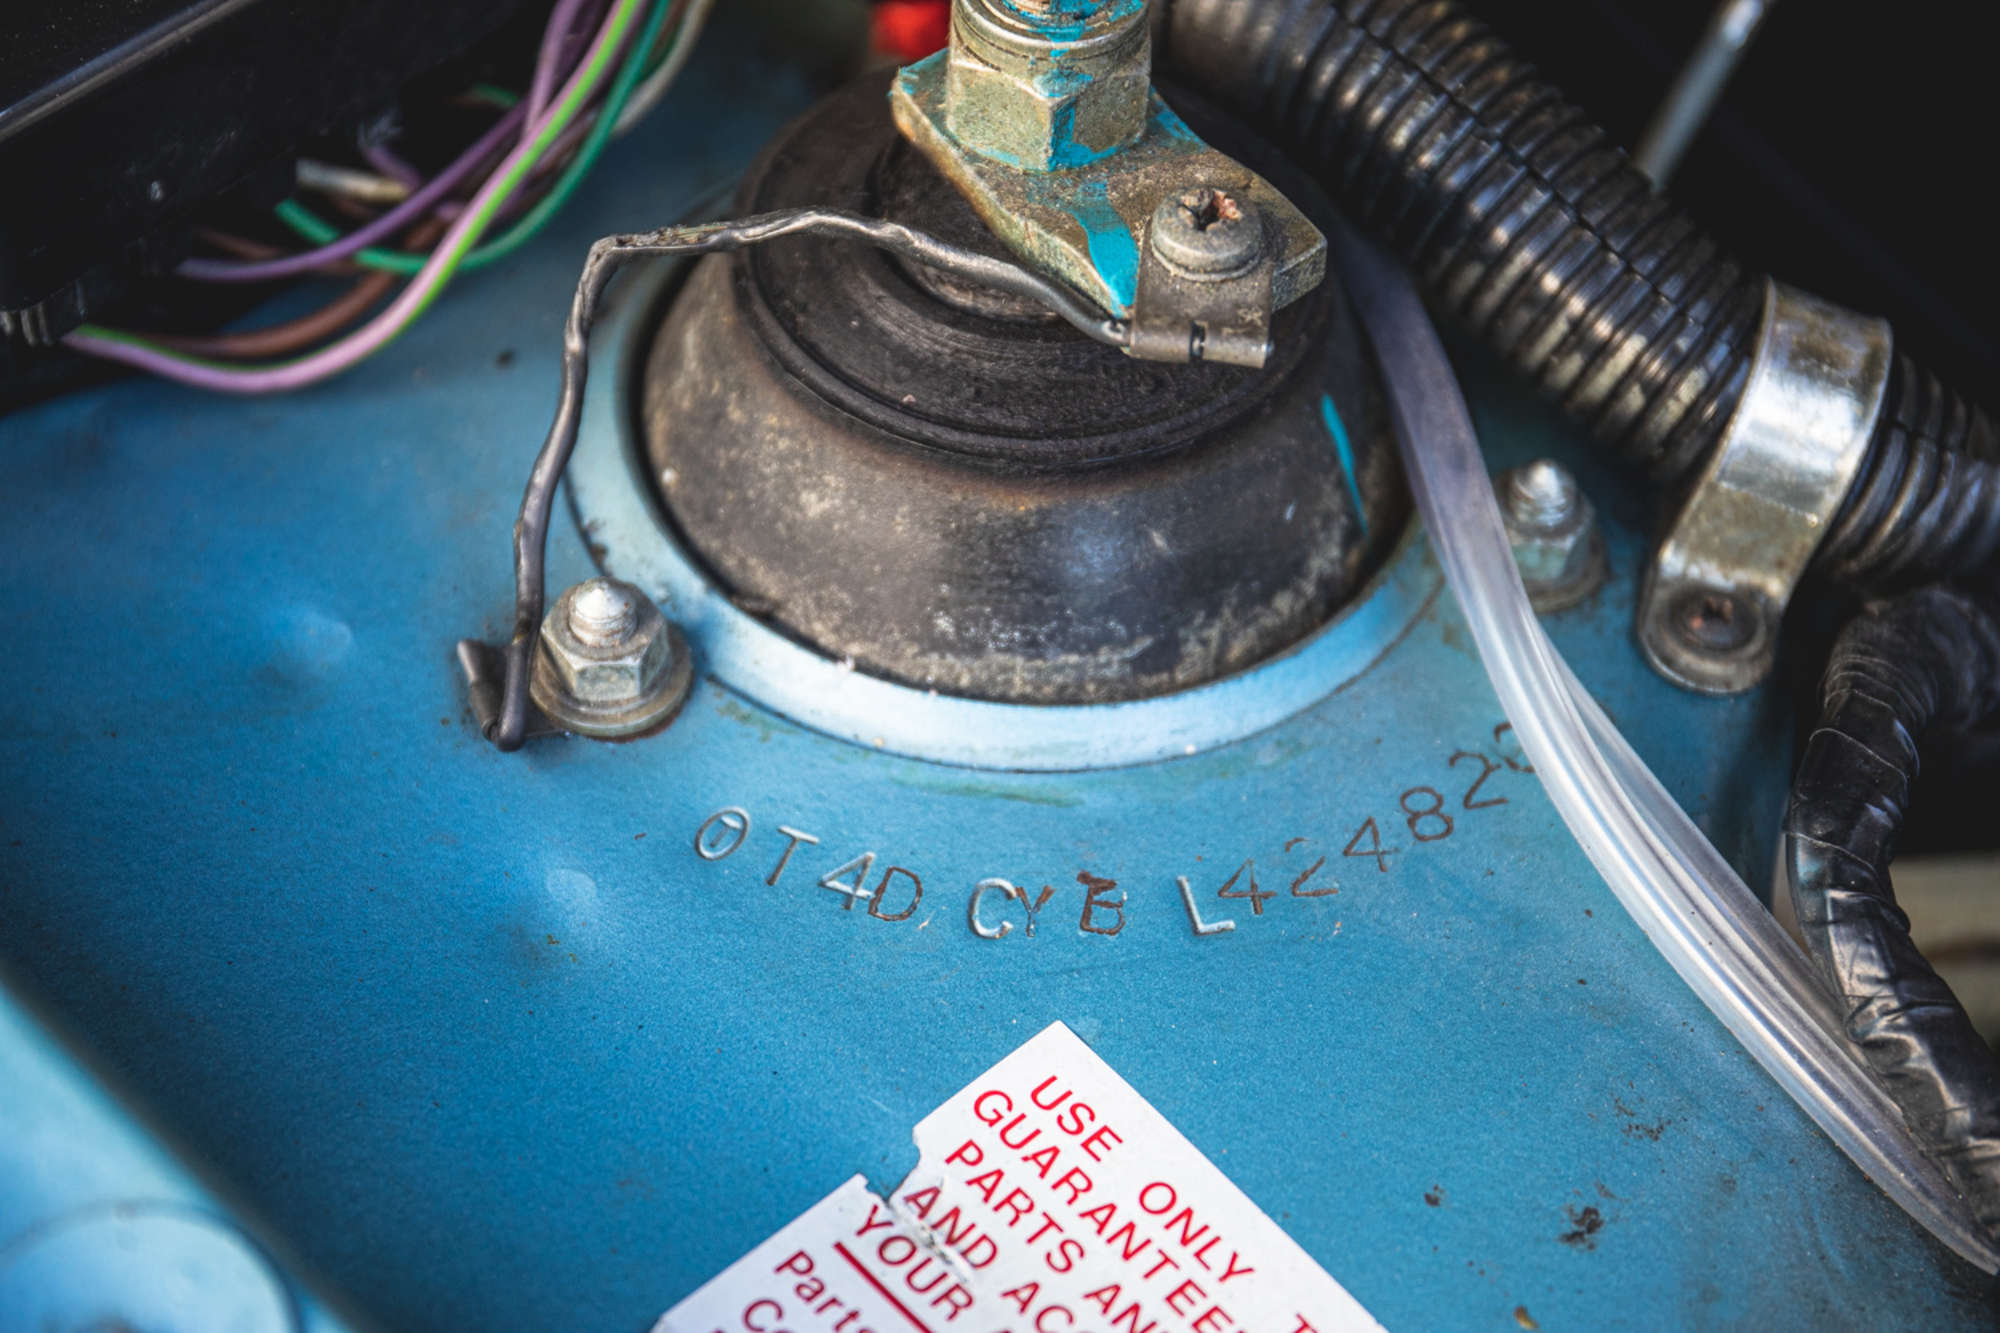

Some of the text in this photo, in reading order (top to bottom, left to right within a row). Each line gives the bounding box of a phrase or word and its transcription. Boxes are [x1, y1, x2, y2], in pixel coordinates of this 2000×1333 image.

[903, 1185, 998, 1269] AND
[945, 1139, 1085, 1274] PARTS
[973, 1089, 1246, 1333] GUARANTEE
[1030, 1074, 1255, 1283] USE ONLY
[774, 1250, 874, 1333] Part
[855, 1203, 974, 1322] YOUR
